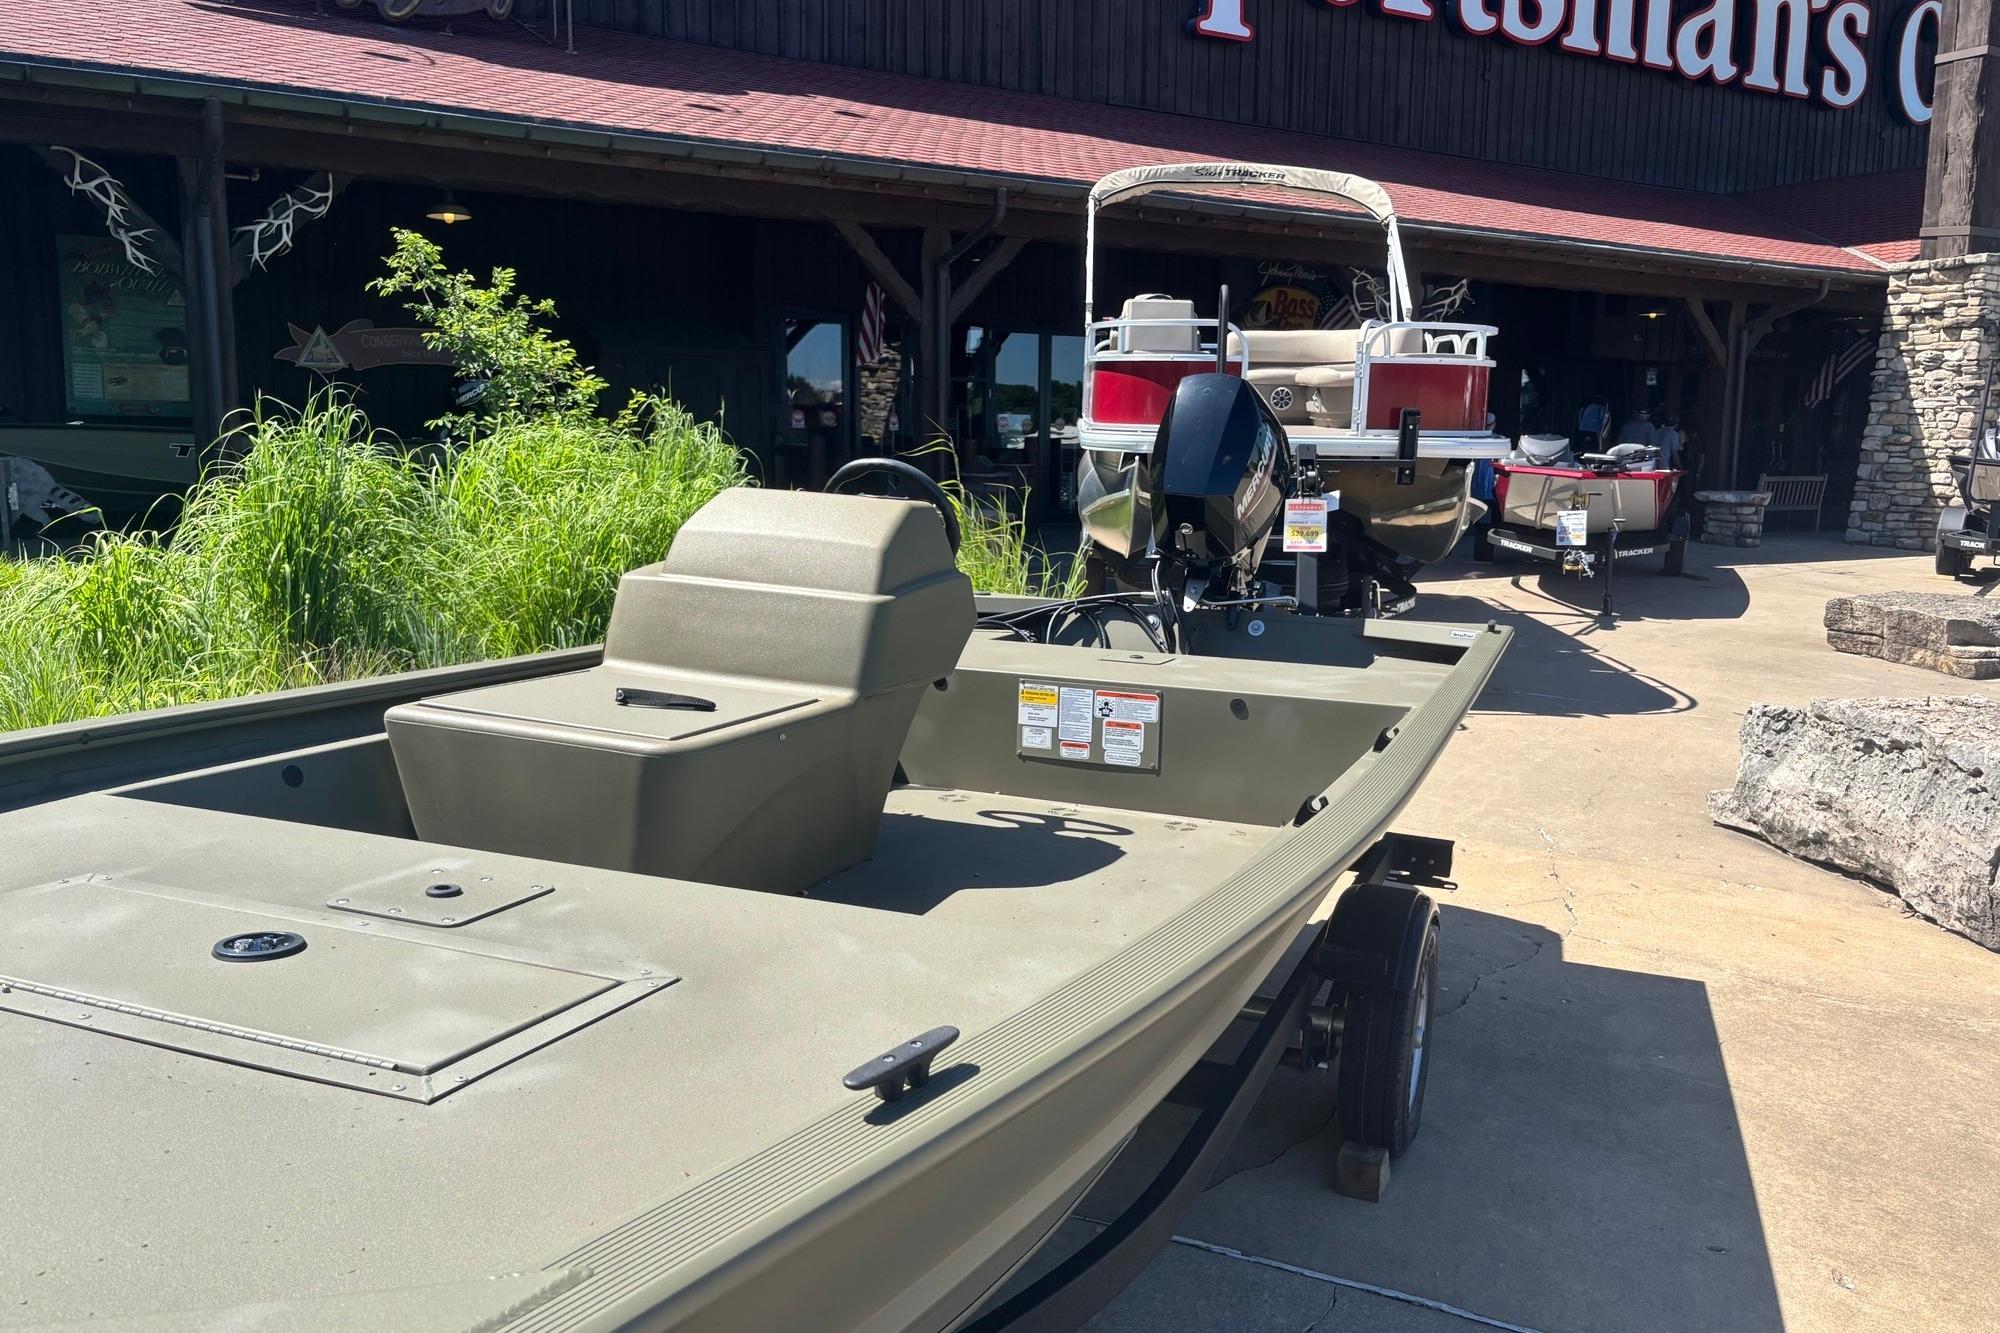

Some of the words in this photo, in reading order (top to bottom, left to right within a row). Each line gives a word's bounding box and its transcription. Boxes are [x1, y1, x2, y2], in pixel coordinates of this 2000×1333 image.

[1224, 169, 1286, 180] TRACKER
[1273, 289, 1317, 319] Bass
[1500, 539, 1533, 553] TRACKER
[1618, 547, 1654, 558] TRACKER
